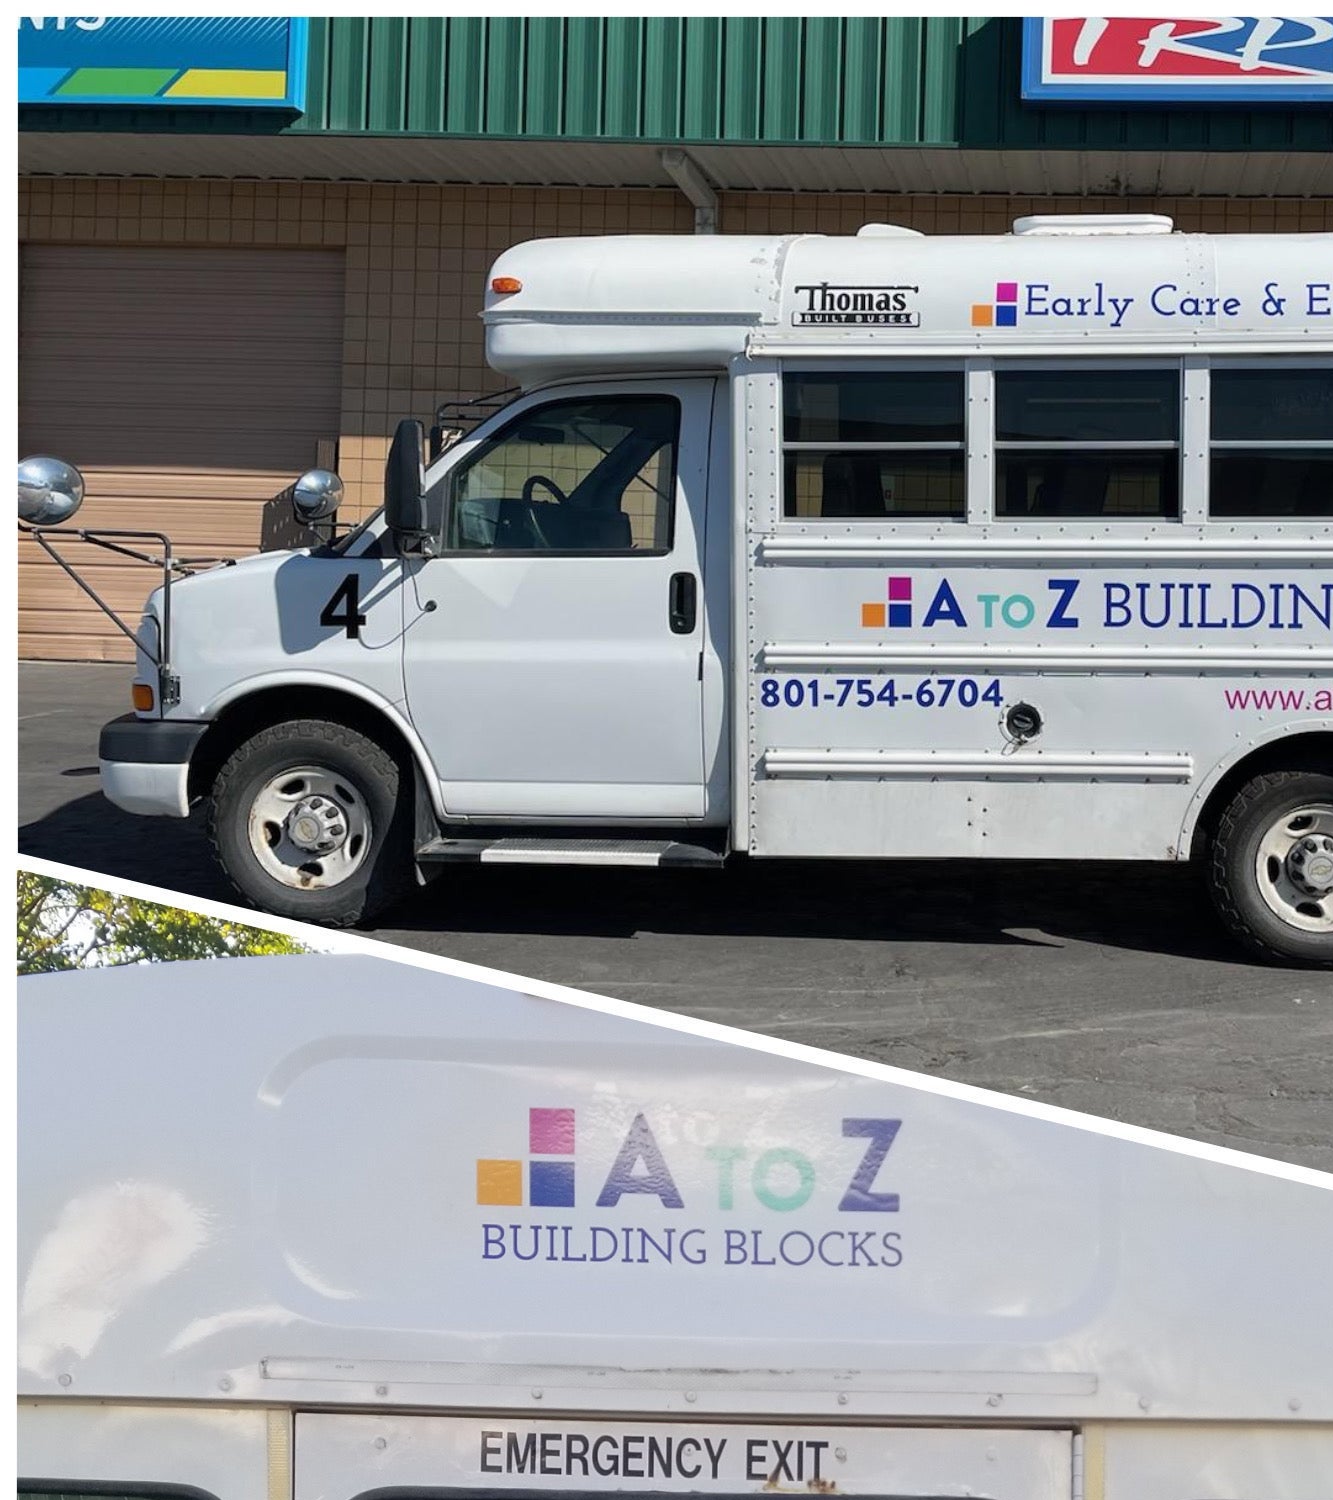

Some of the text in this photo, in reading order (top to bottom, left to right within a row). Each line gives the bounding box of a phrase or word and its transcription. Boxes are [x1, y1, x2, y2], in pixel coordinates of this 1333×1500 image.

[797, 282, 916, 311] Thomas
[804, 314, 907, 323] BUILT BUSES
[1024, 283, 1133, 326] Early
[1150, 284, 1241, 317] Care
[1261, 283, 1286, 317] &
[320, 574, 365, 638] 4
[923, 578, 968, 628] A
[1046, 579, 1080, 628] Z
[761, 679, 1004, 708] 801-754-6704
[595, 1111, 685, 1209] A
[837, 1117, 903, 1213] Z
[481, 1223, 903, 1268] BUILDING BLOCKS
[480, 1430, 829, 1482] EMERGENCY EXIT
